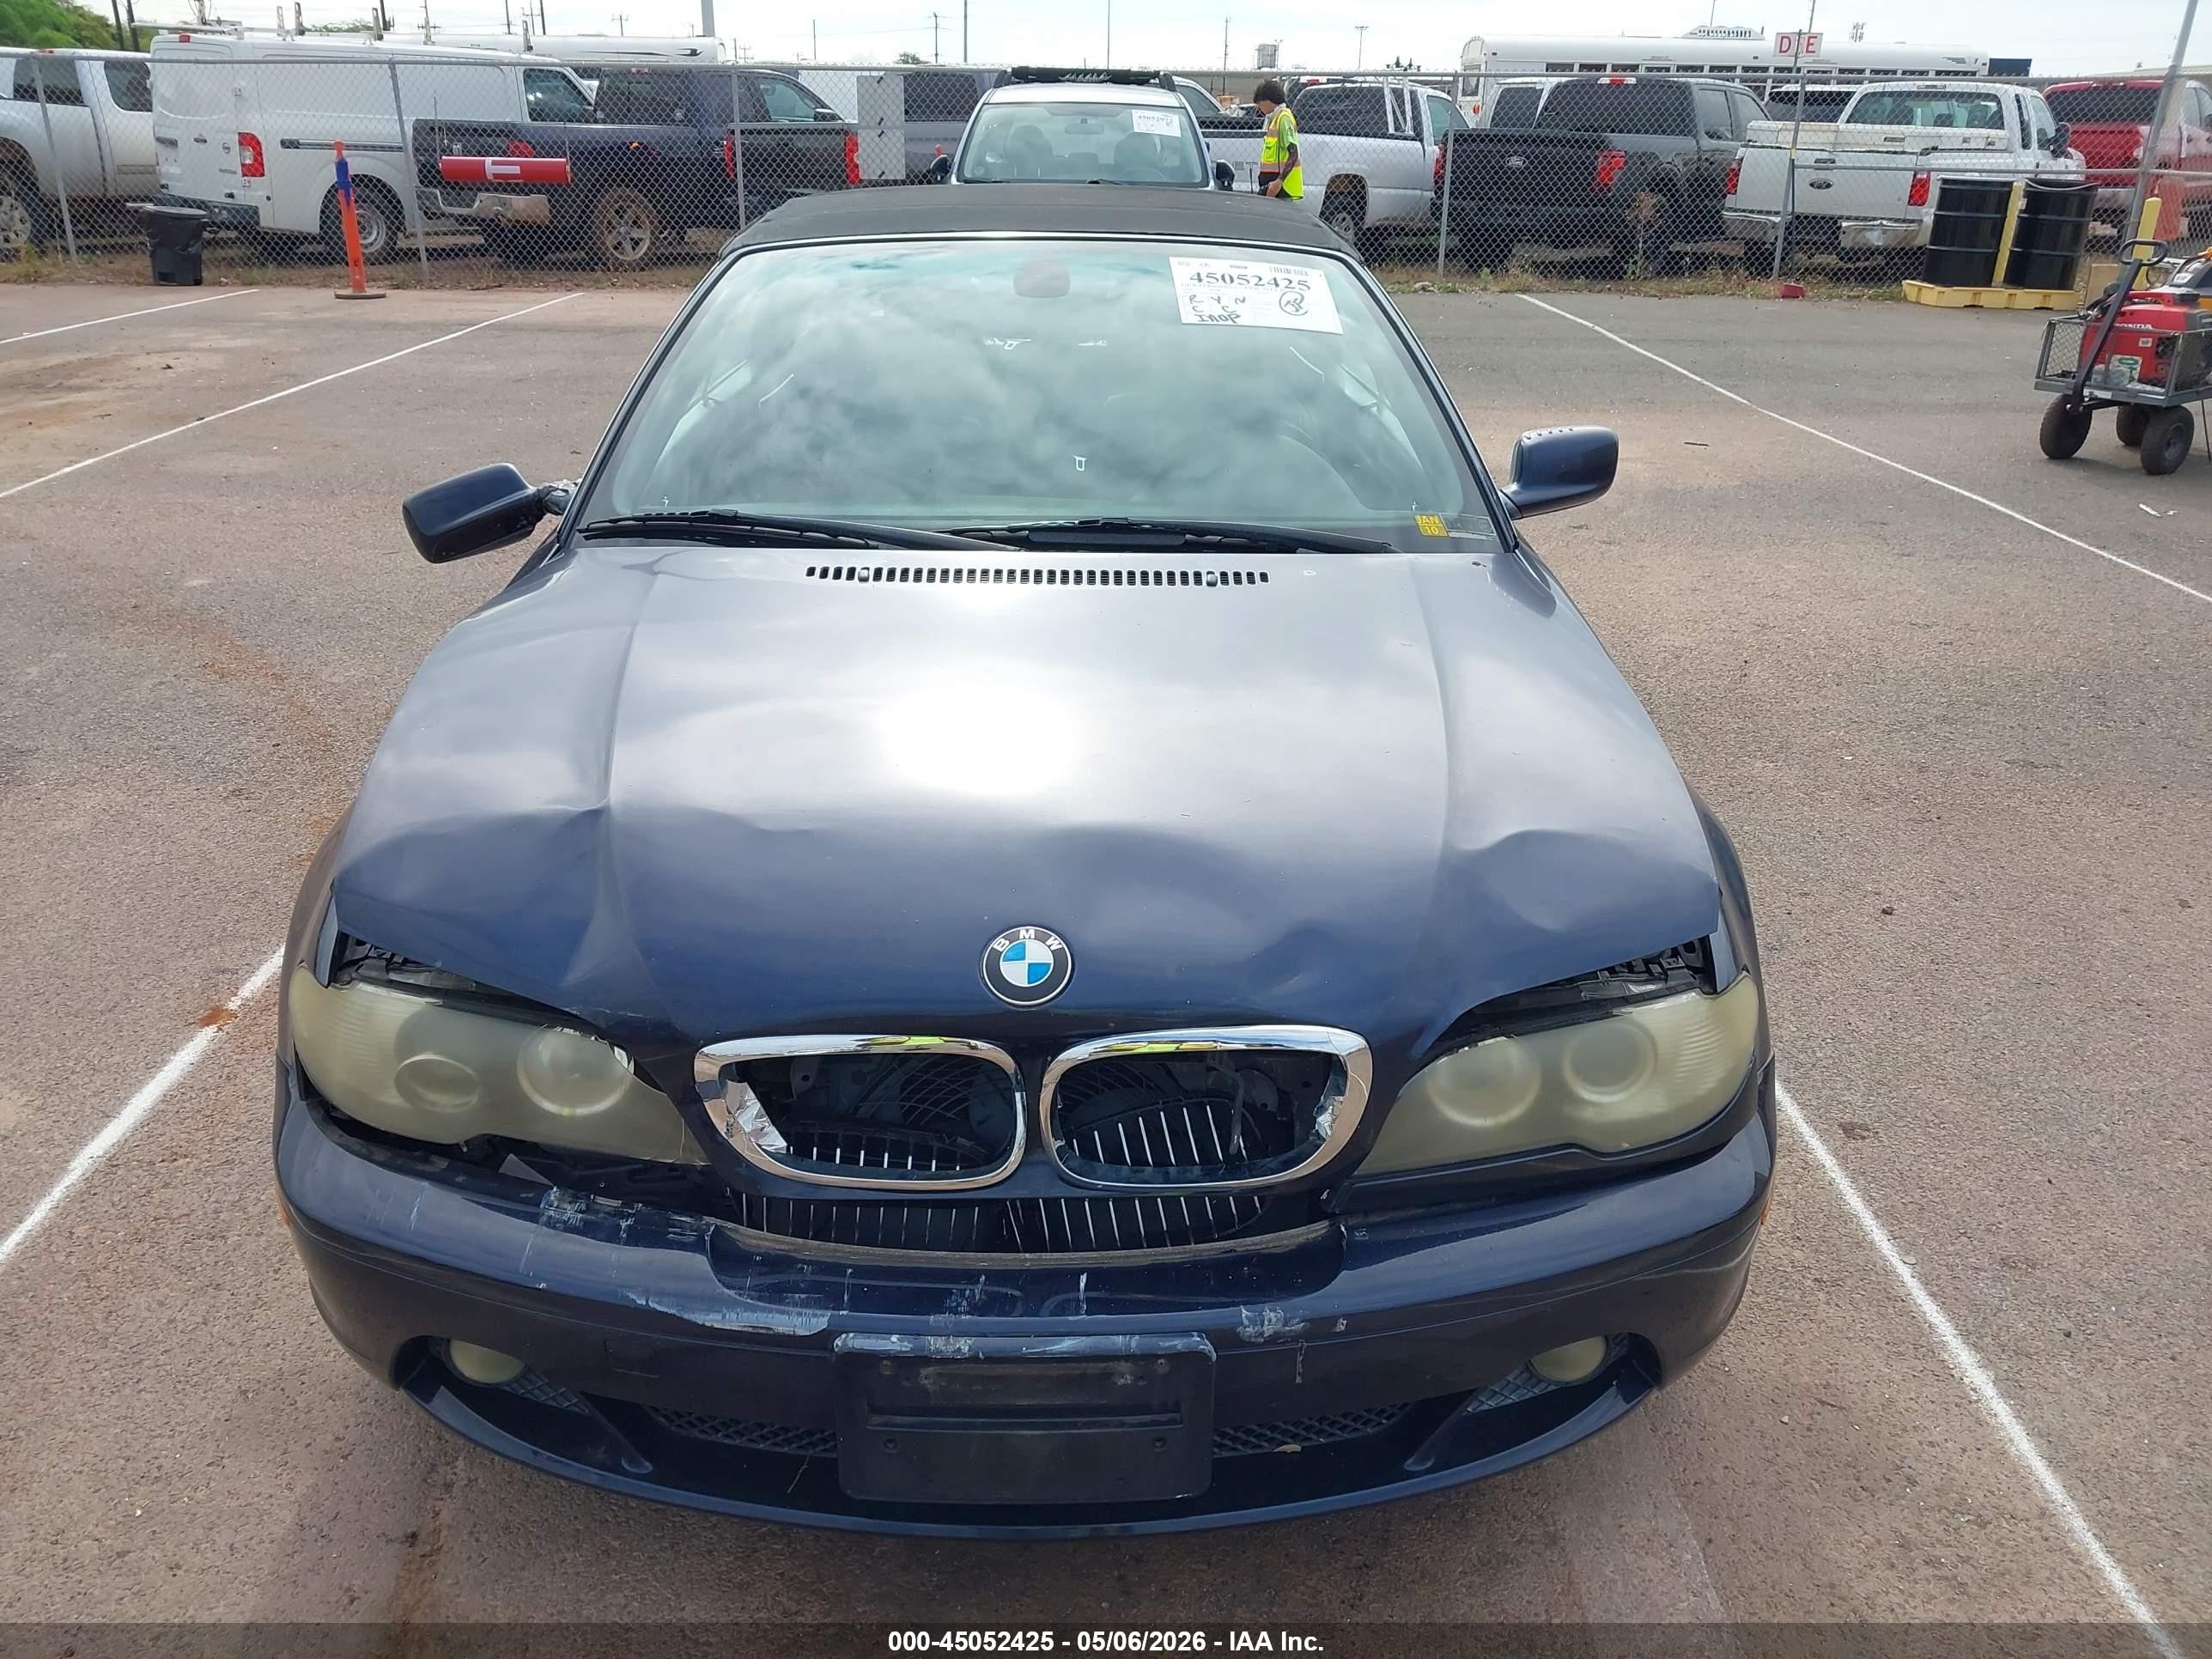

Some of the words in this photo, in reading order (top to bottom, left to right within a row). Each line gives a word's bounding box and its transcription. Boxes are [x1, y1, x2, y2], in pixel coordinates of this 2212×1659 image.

[1779, 36, 1791, 53] D
[1806, 36, 1818, 53] E
[1189, 271, 1311, 290] 45052425
[1417, 515, 1439, 524] JAN
[993, 929, 1063, 952] BMW
